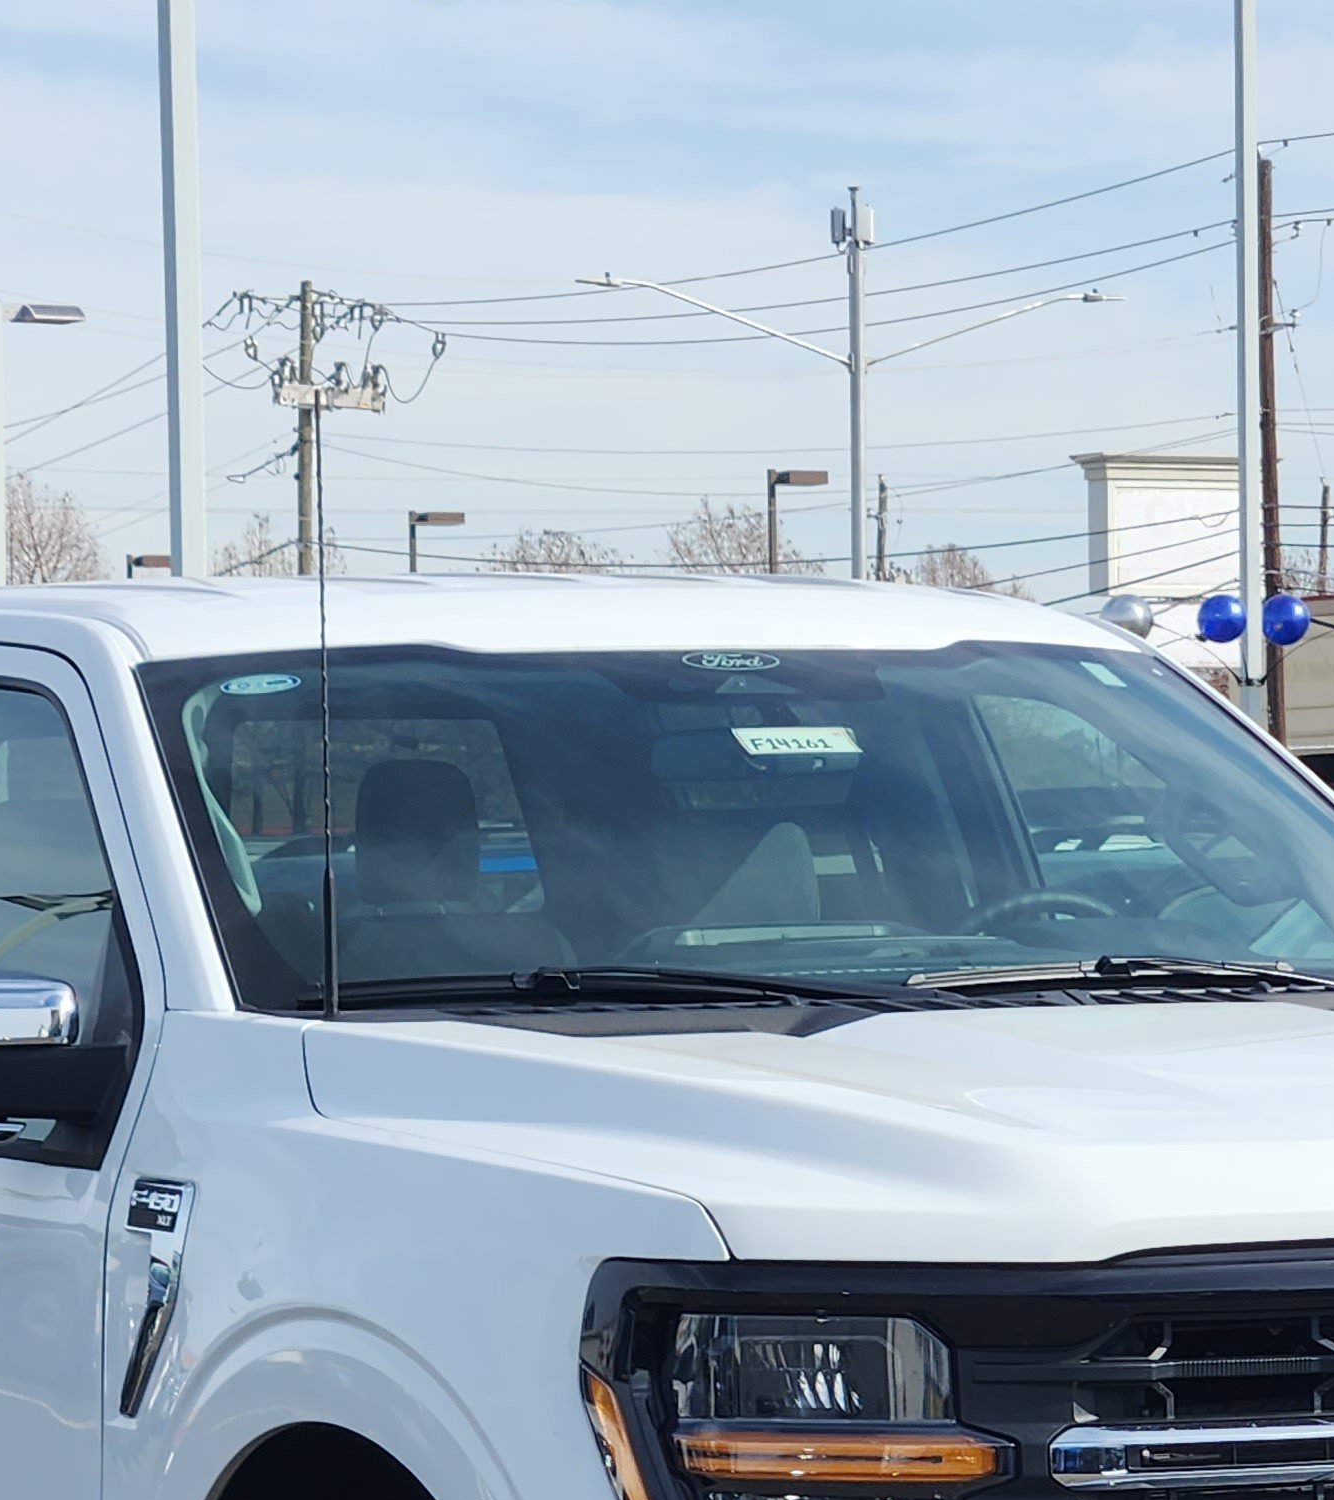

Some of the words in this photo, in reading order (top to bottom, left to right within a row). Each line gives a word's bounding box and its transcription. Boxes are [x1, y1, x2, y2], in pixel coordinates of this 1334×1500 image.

[701, 652, 765, 668] Ford
[749, 737, 833, 751] F14161
[155, 1214, 174, 1227] XLT
